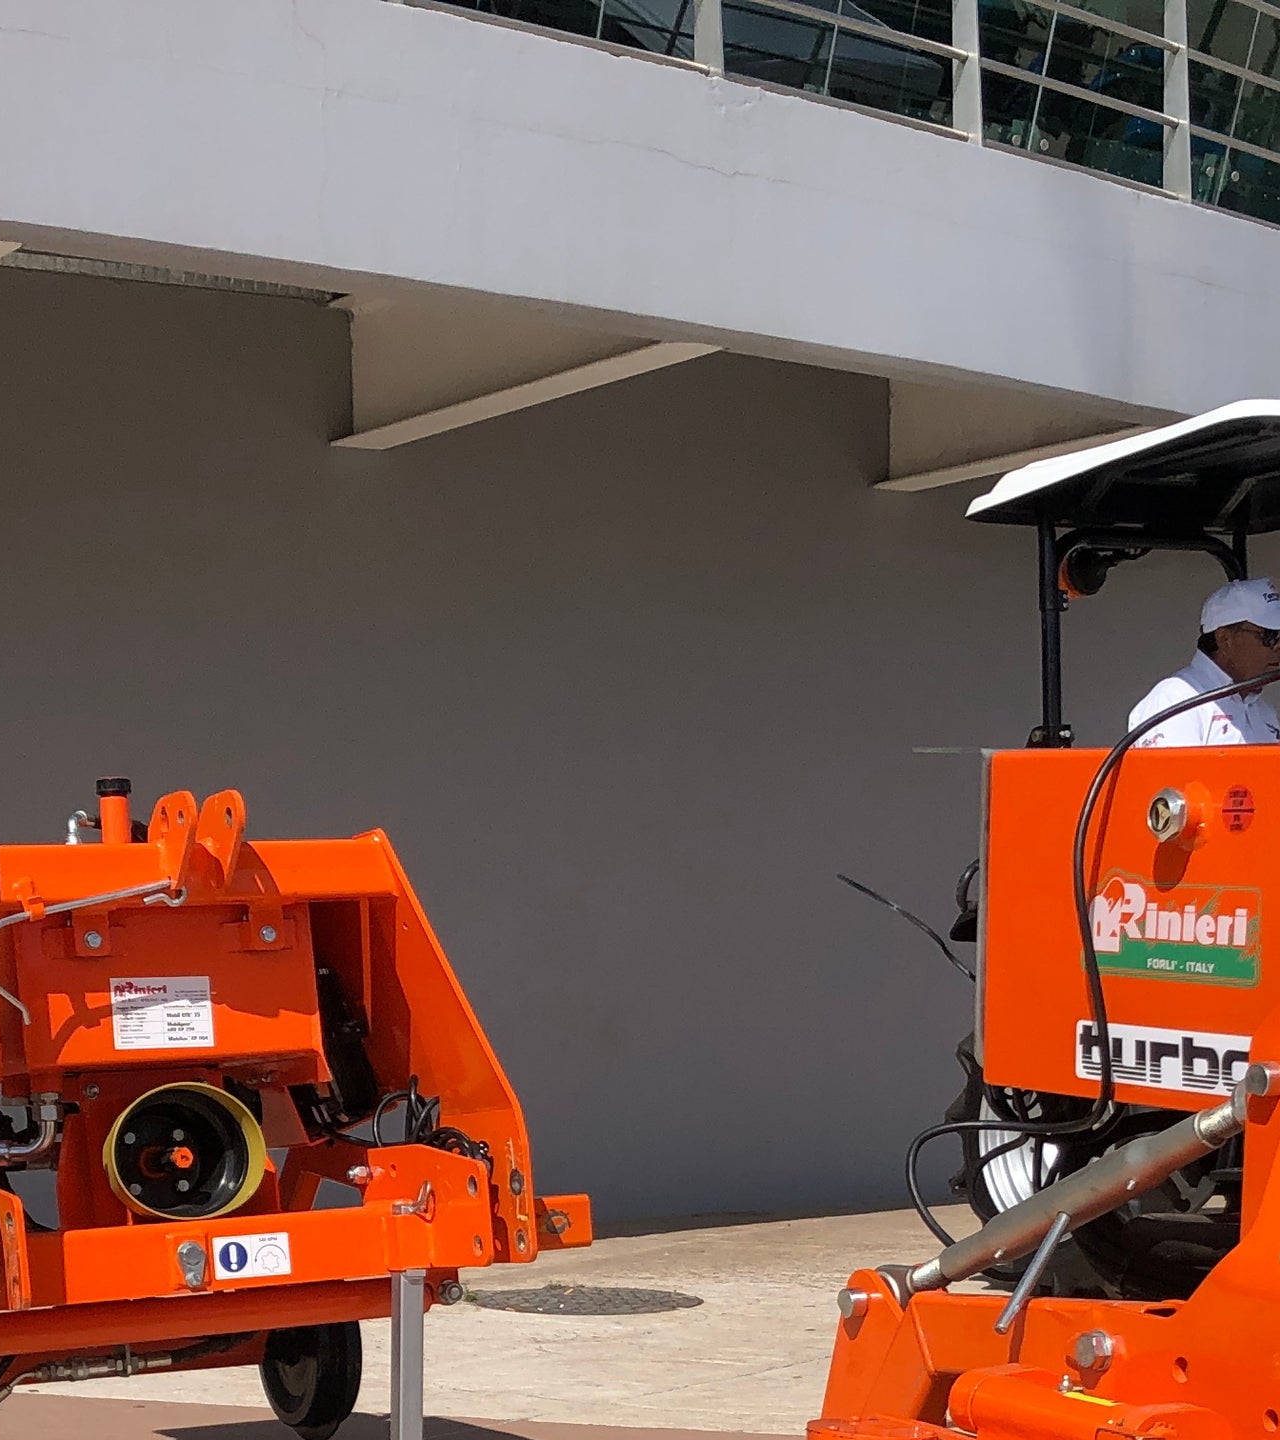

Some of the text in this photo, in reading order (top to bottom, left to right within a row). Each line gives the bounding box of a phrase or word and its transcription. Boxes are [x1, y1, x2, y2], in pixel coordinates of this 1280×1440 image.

[1112, 881, 1250, 948] Rinieri
[1185, 959, 1215, 974] ITALY
[124, 981, 168, 995] Rinieri
